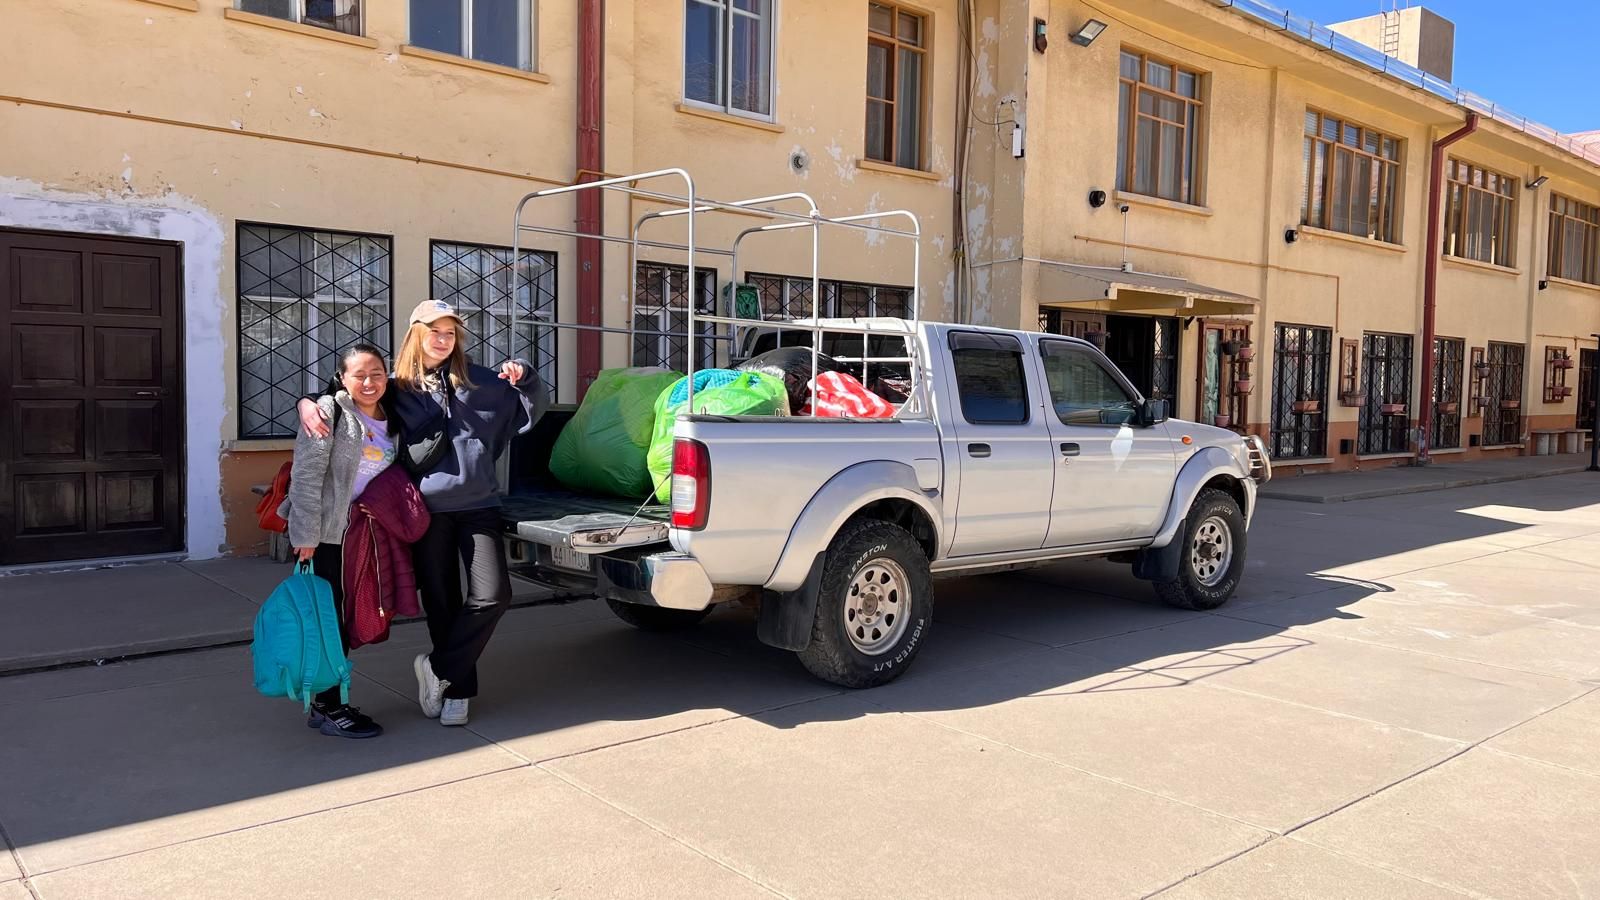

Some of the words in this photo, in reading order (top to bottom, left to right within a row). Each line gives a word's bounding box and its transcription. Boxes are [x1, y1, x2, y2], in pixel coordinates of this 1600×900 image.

[847, 543, 888, 580] LENSTON
[894, 618, 925, 663] FIGHTER
[873, 660, 893, 672] A/T
